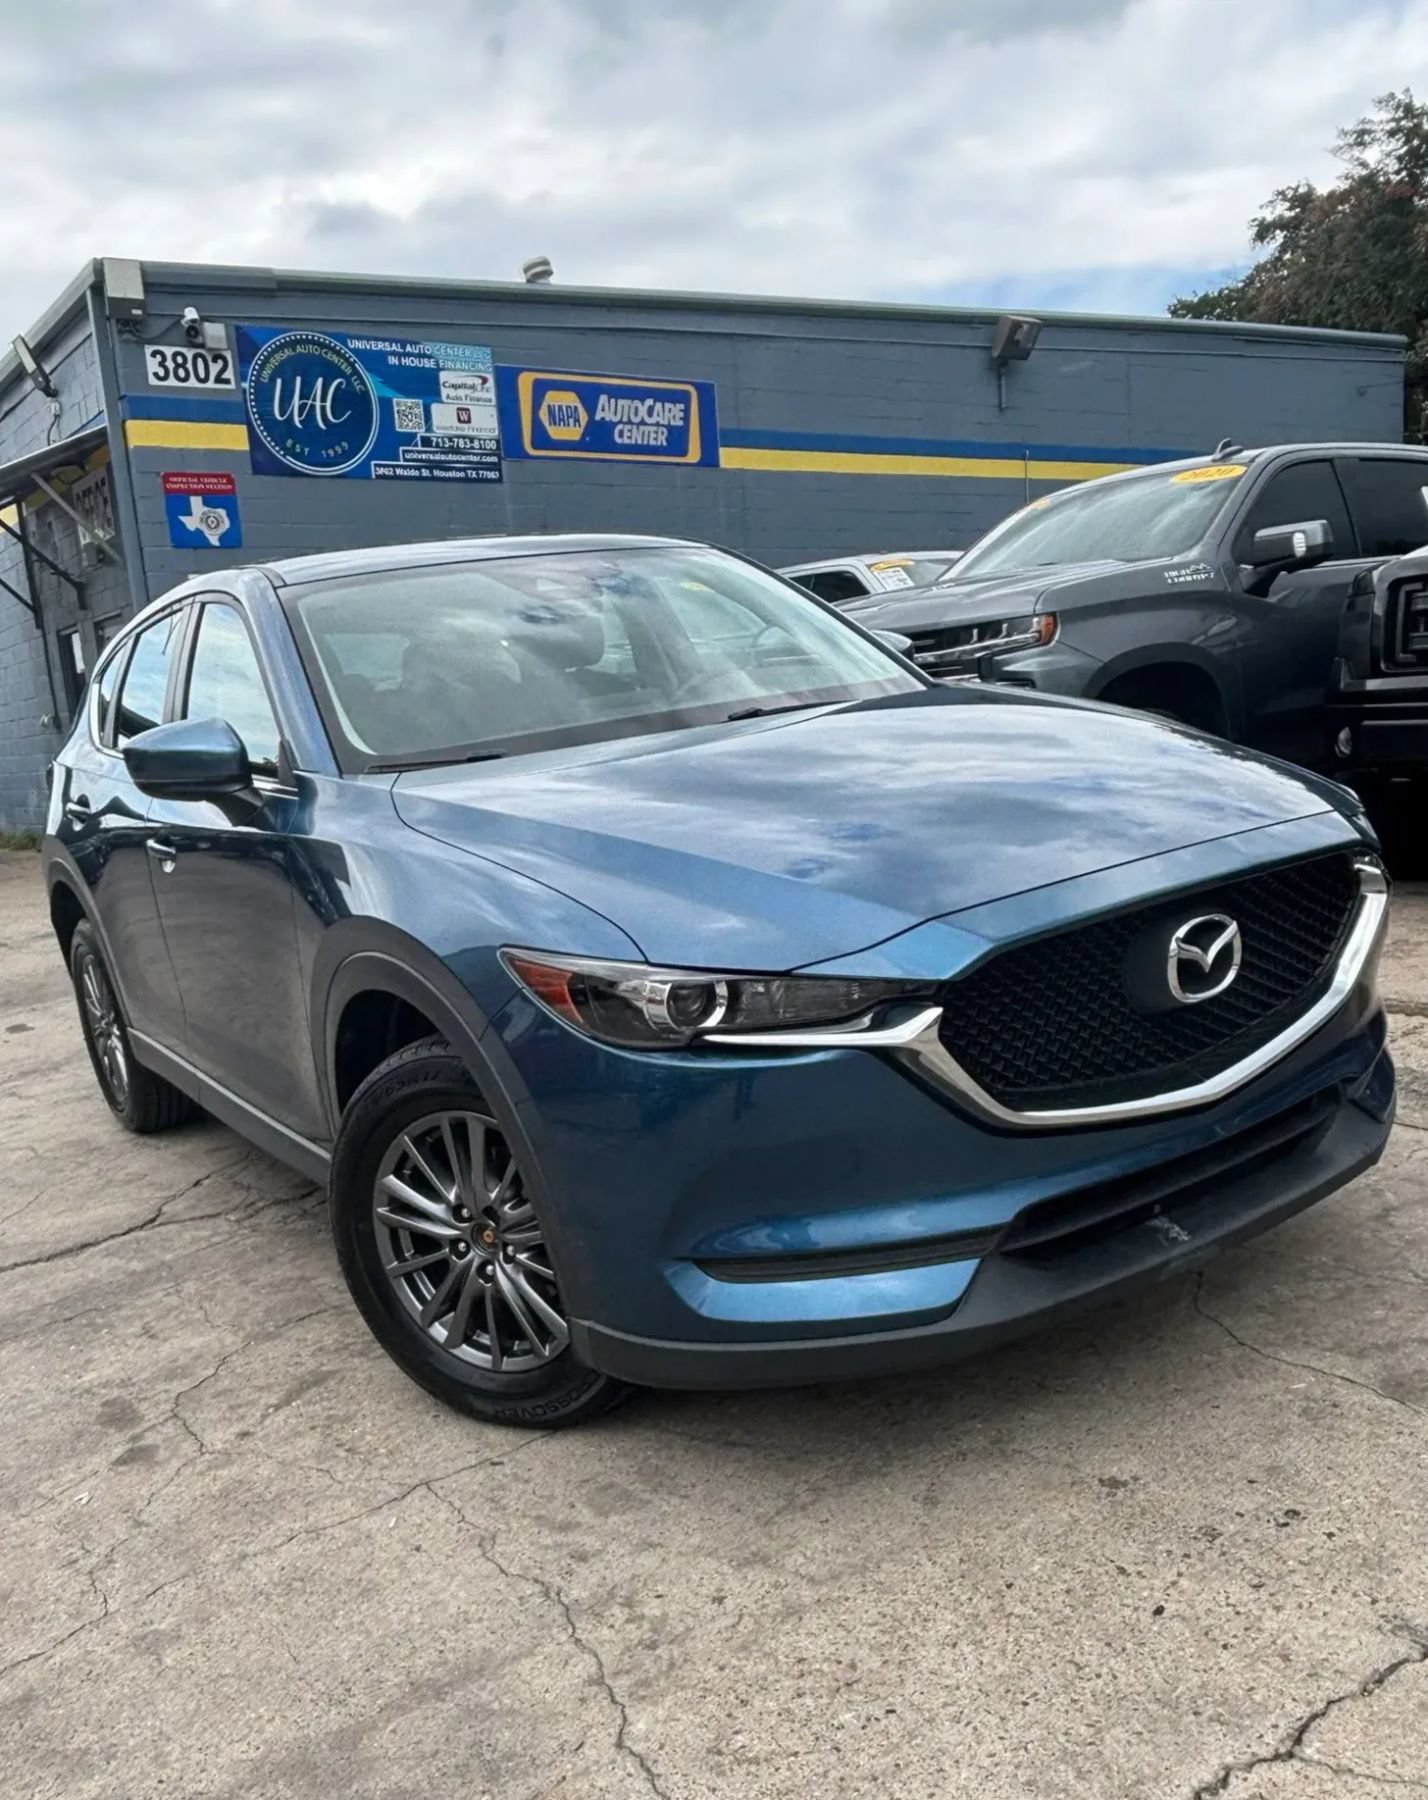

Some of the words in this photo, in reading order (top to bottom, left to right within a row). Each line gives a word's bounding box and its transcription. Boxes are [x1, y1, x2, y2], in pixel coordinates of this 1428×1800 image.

[347, 339, 404, 353] UNIVERSAL
[405, 343, 432, 354] AUTO
[431, 346, 471, 357] CENTER
[150, 349, 232, 385] 3802
[260, 346, 296, 383] UNIVERSAL
[296, 344, 320, 355] AUTO
[321, 349, 353, 376] CENTER
[388, 356, 399, 365] IN
[401, 356, 437, 368] HOUSE
[439, 361, 493, 372] FINANCING
[273, 375, 352, 430] UAC
[547, 403, 582, 428] NAPA
[430, 437, 497, 449] 713-783-8100
[614, 424, 668, 447] CENTER
[286, 438, 310, 456] EST
[404, 452, 498, 463] universalautocenter.com
[433, 468, 465, 478] Houston
[467, 470, 477, 478] TX
